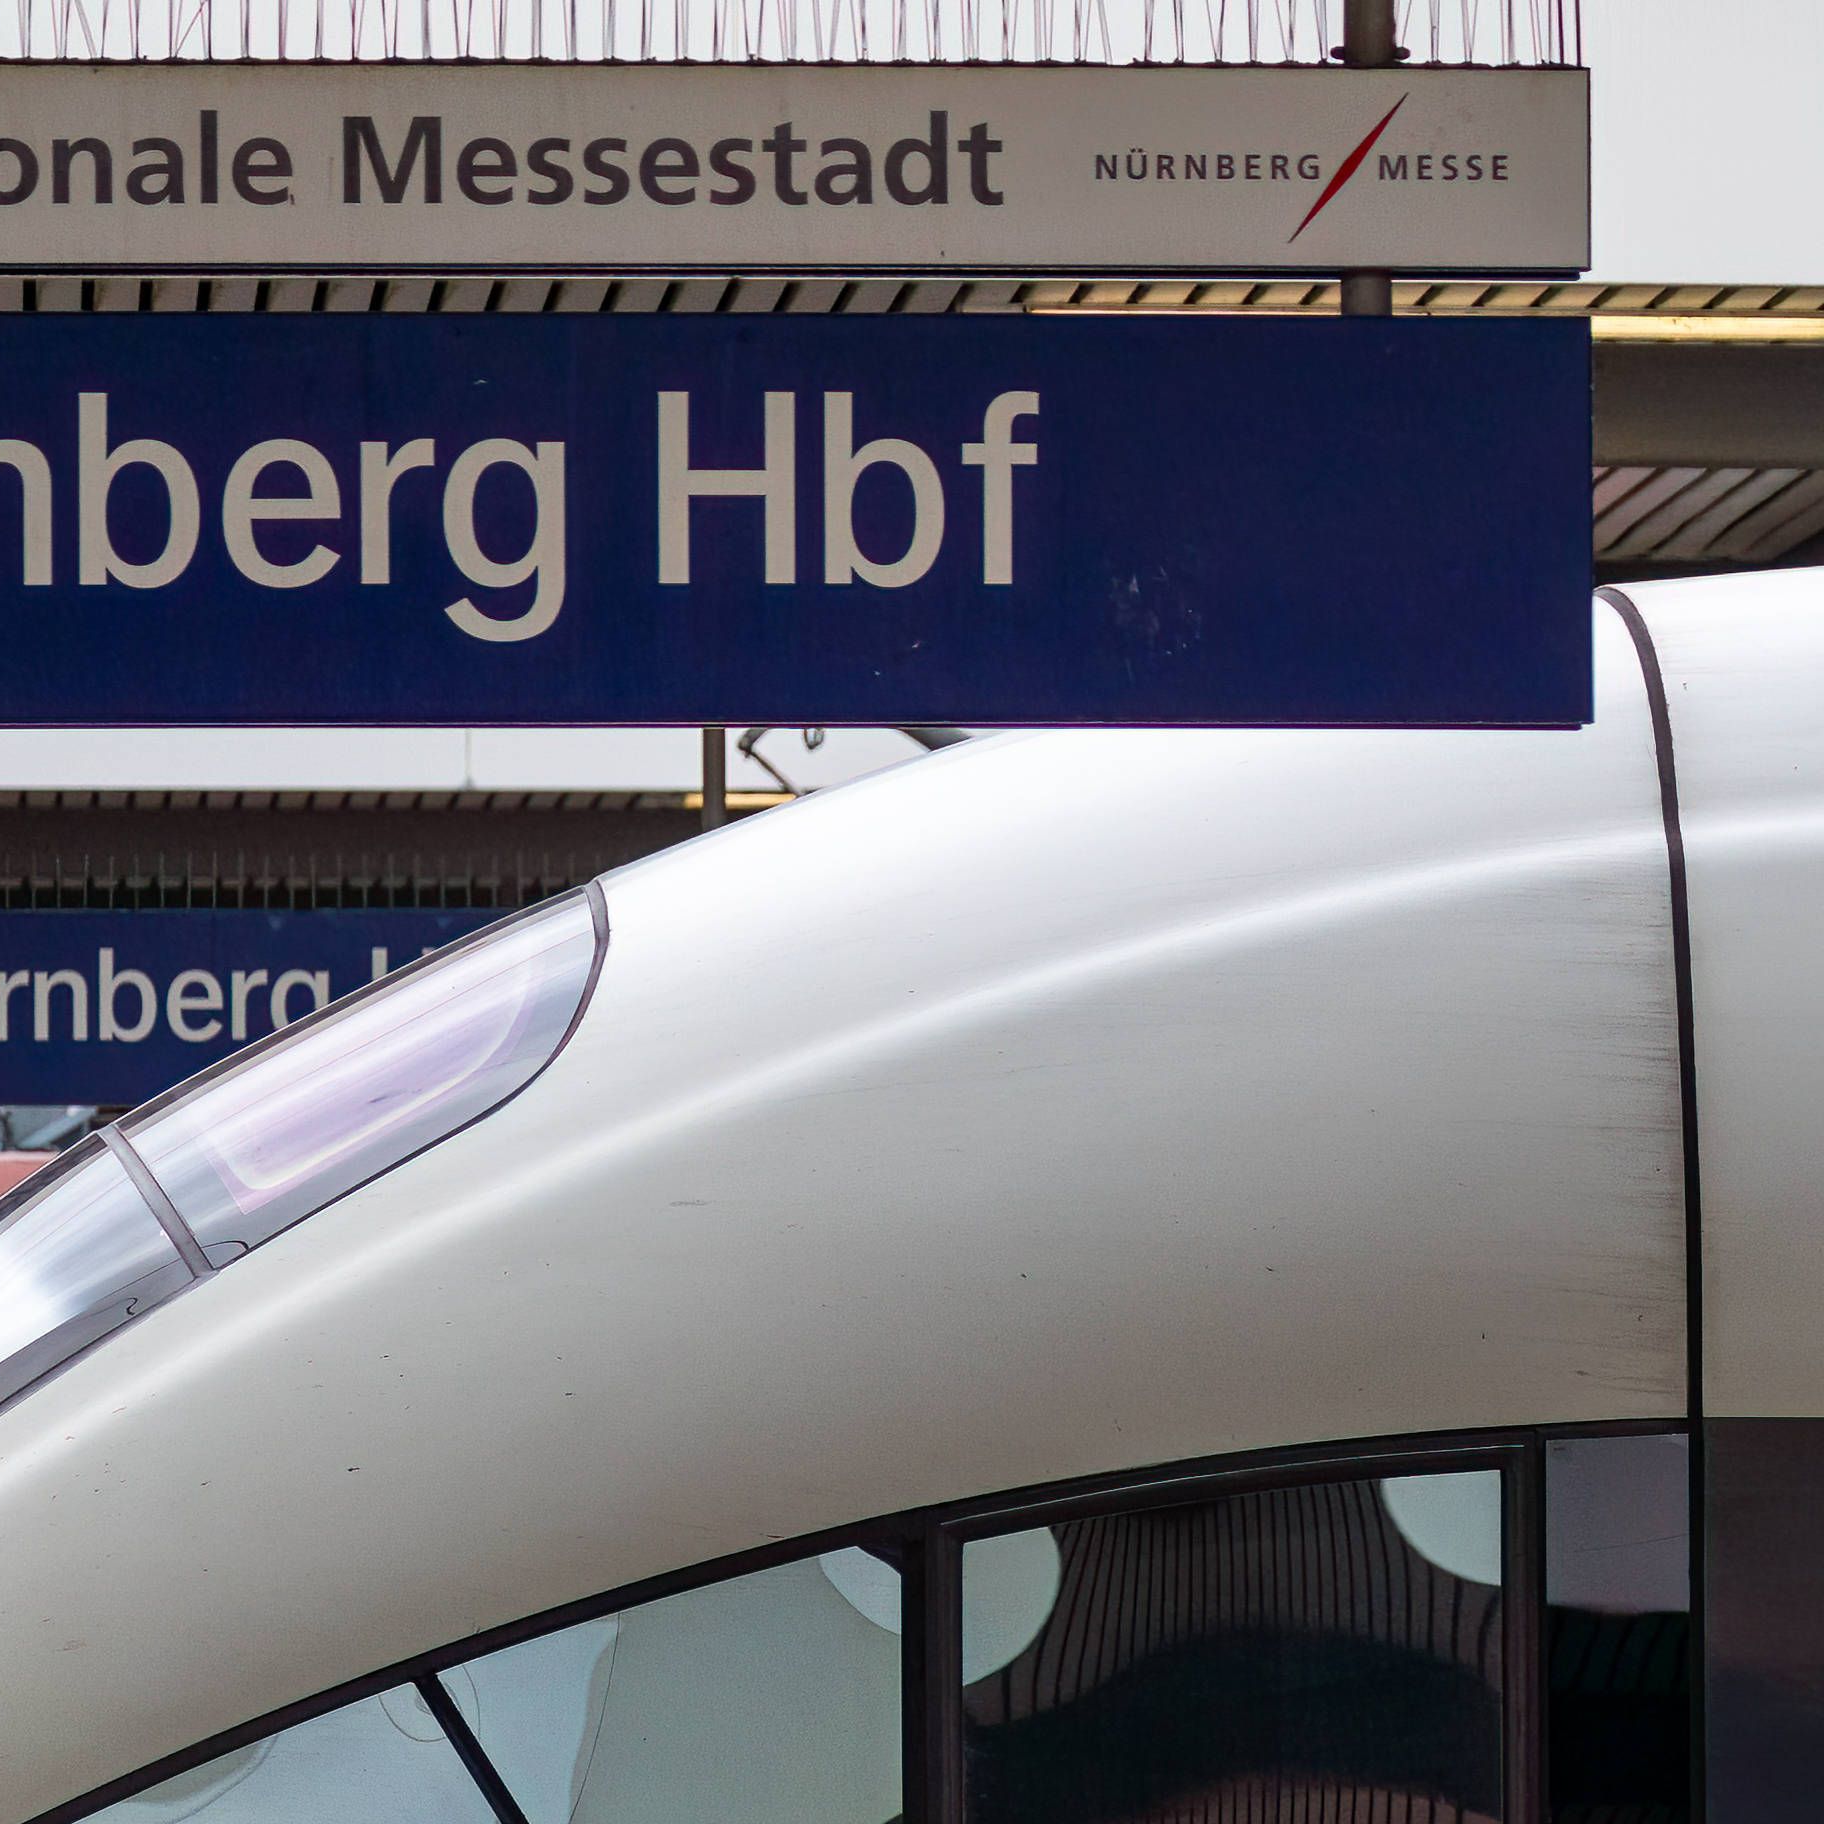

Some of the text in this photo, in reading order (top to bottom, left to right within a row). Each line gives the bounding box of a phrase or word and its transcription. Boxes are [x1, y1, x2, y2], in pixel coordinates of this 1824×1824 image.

[343, 111, 1005, 205] Messestadt
[1095, 147, 1510, 182] NÜRNBERG MESSE
[658, 390, 1040, 588] Hbf
